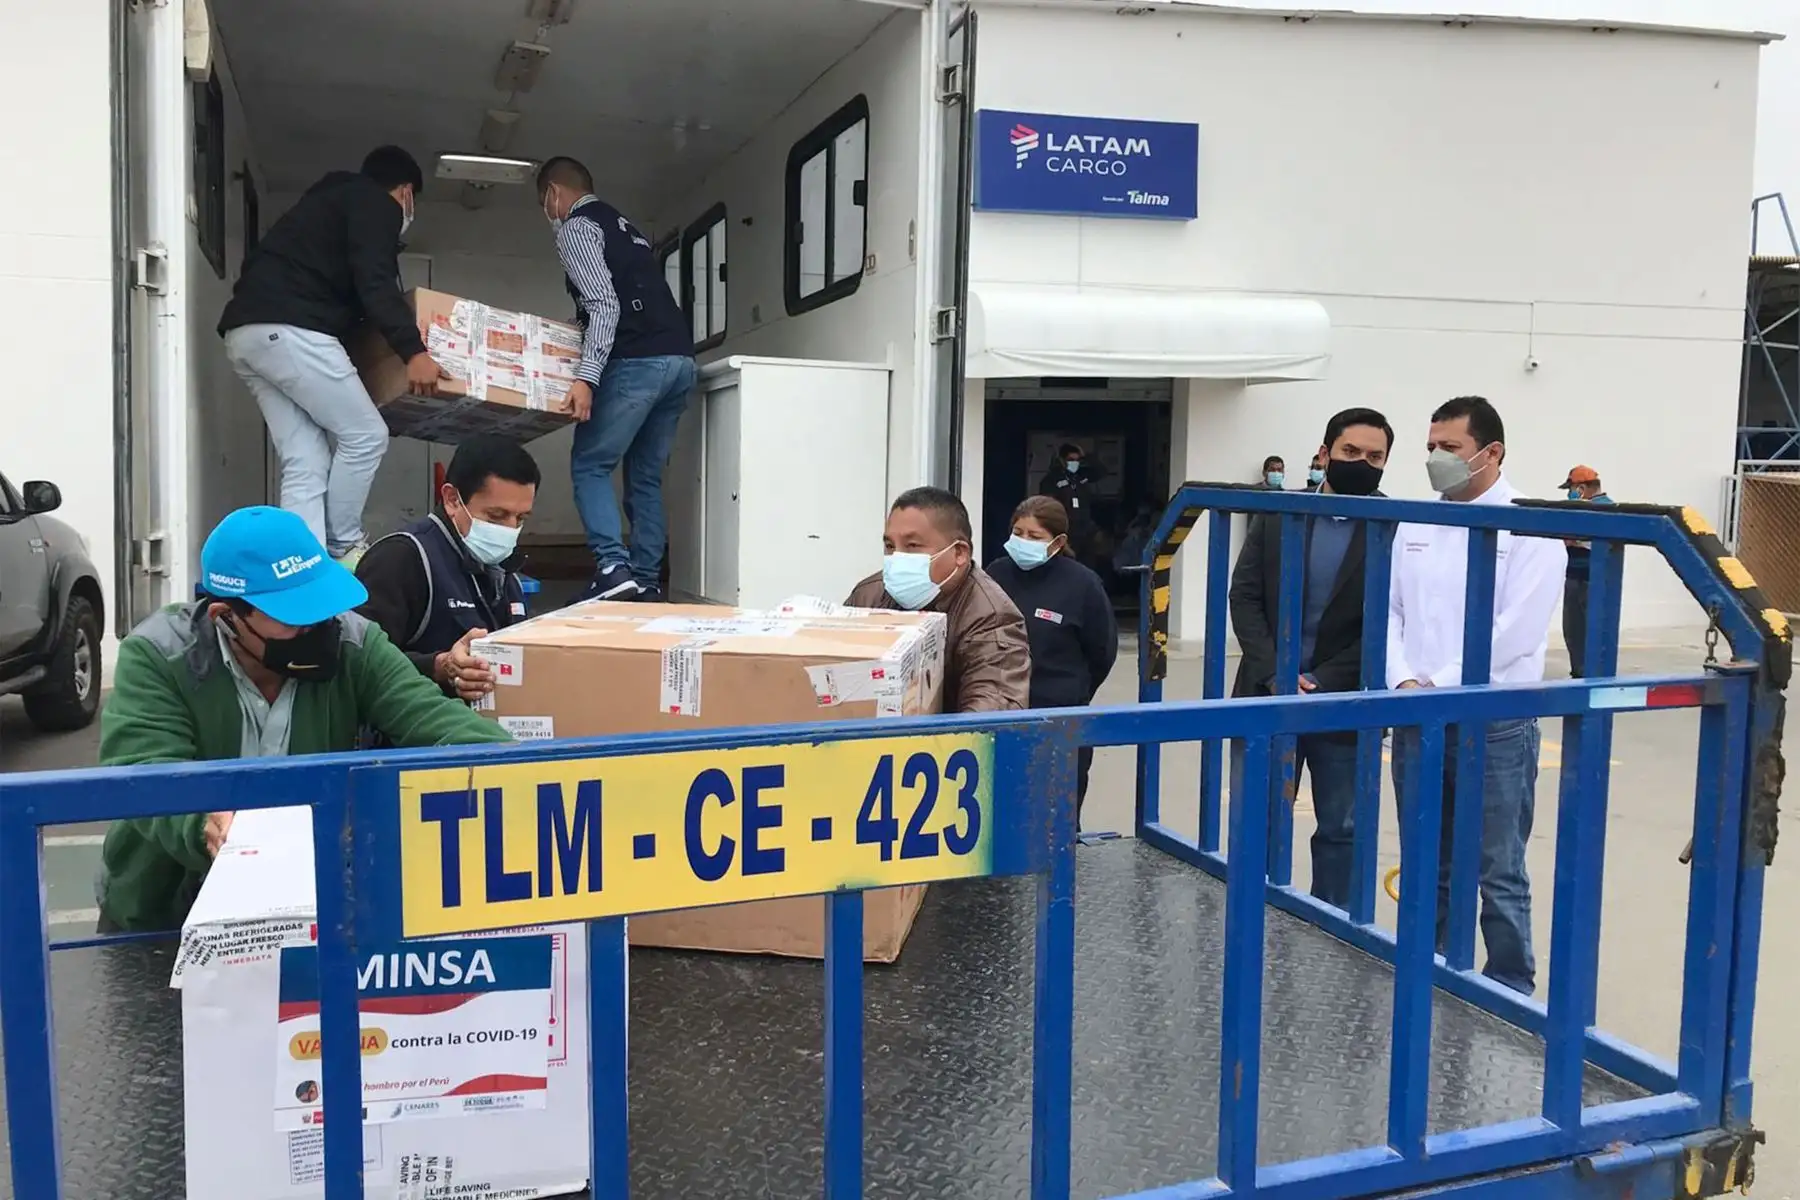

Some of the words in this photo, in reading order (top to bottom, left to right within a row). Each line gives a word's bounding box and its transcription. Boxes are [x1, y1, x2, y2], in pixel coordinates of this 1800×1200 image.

[1046, 133, 1151, 157] LATAM
[1046, 157, 1127, 176] CARGO
[1127, 190, 1170, 206] Talma
[420, 778, 603, 909] TLM
[684, 763, 786, 882] CE
[855, 748, 983, 863] 423
[232, 923, 304, 938] REFRIGERADAS
[219, 939, 250, 949] LUGAR
[250, 934, 284, 946] FRESCO
[217, 947, 245, 957] ENTRE
[391, 1030, 443, 1049] contra
[448, 1029, 462, 1046] la
[466, 1027, 538, 1045] COVID-19
[364, 1081, 400, 1092] hombro
[400, 1081, 417, 1091] por
[418, 1078, 427, 1087] el
[428, 1077, 451, 1086] Perú
[430, 1186, 451, 1196] LIFE
[454, 1182, 491, 1193] SAVING
